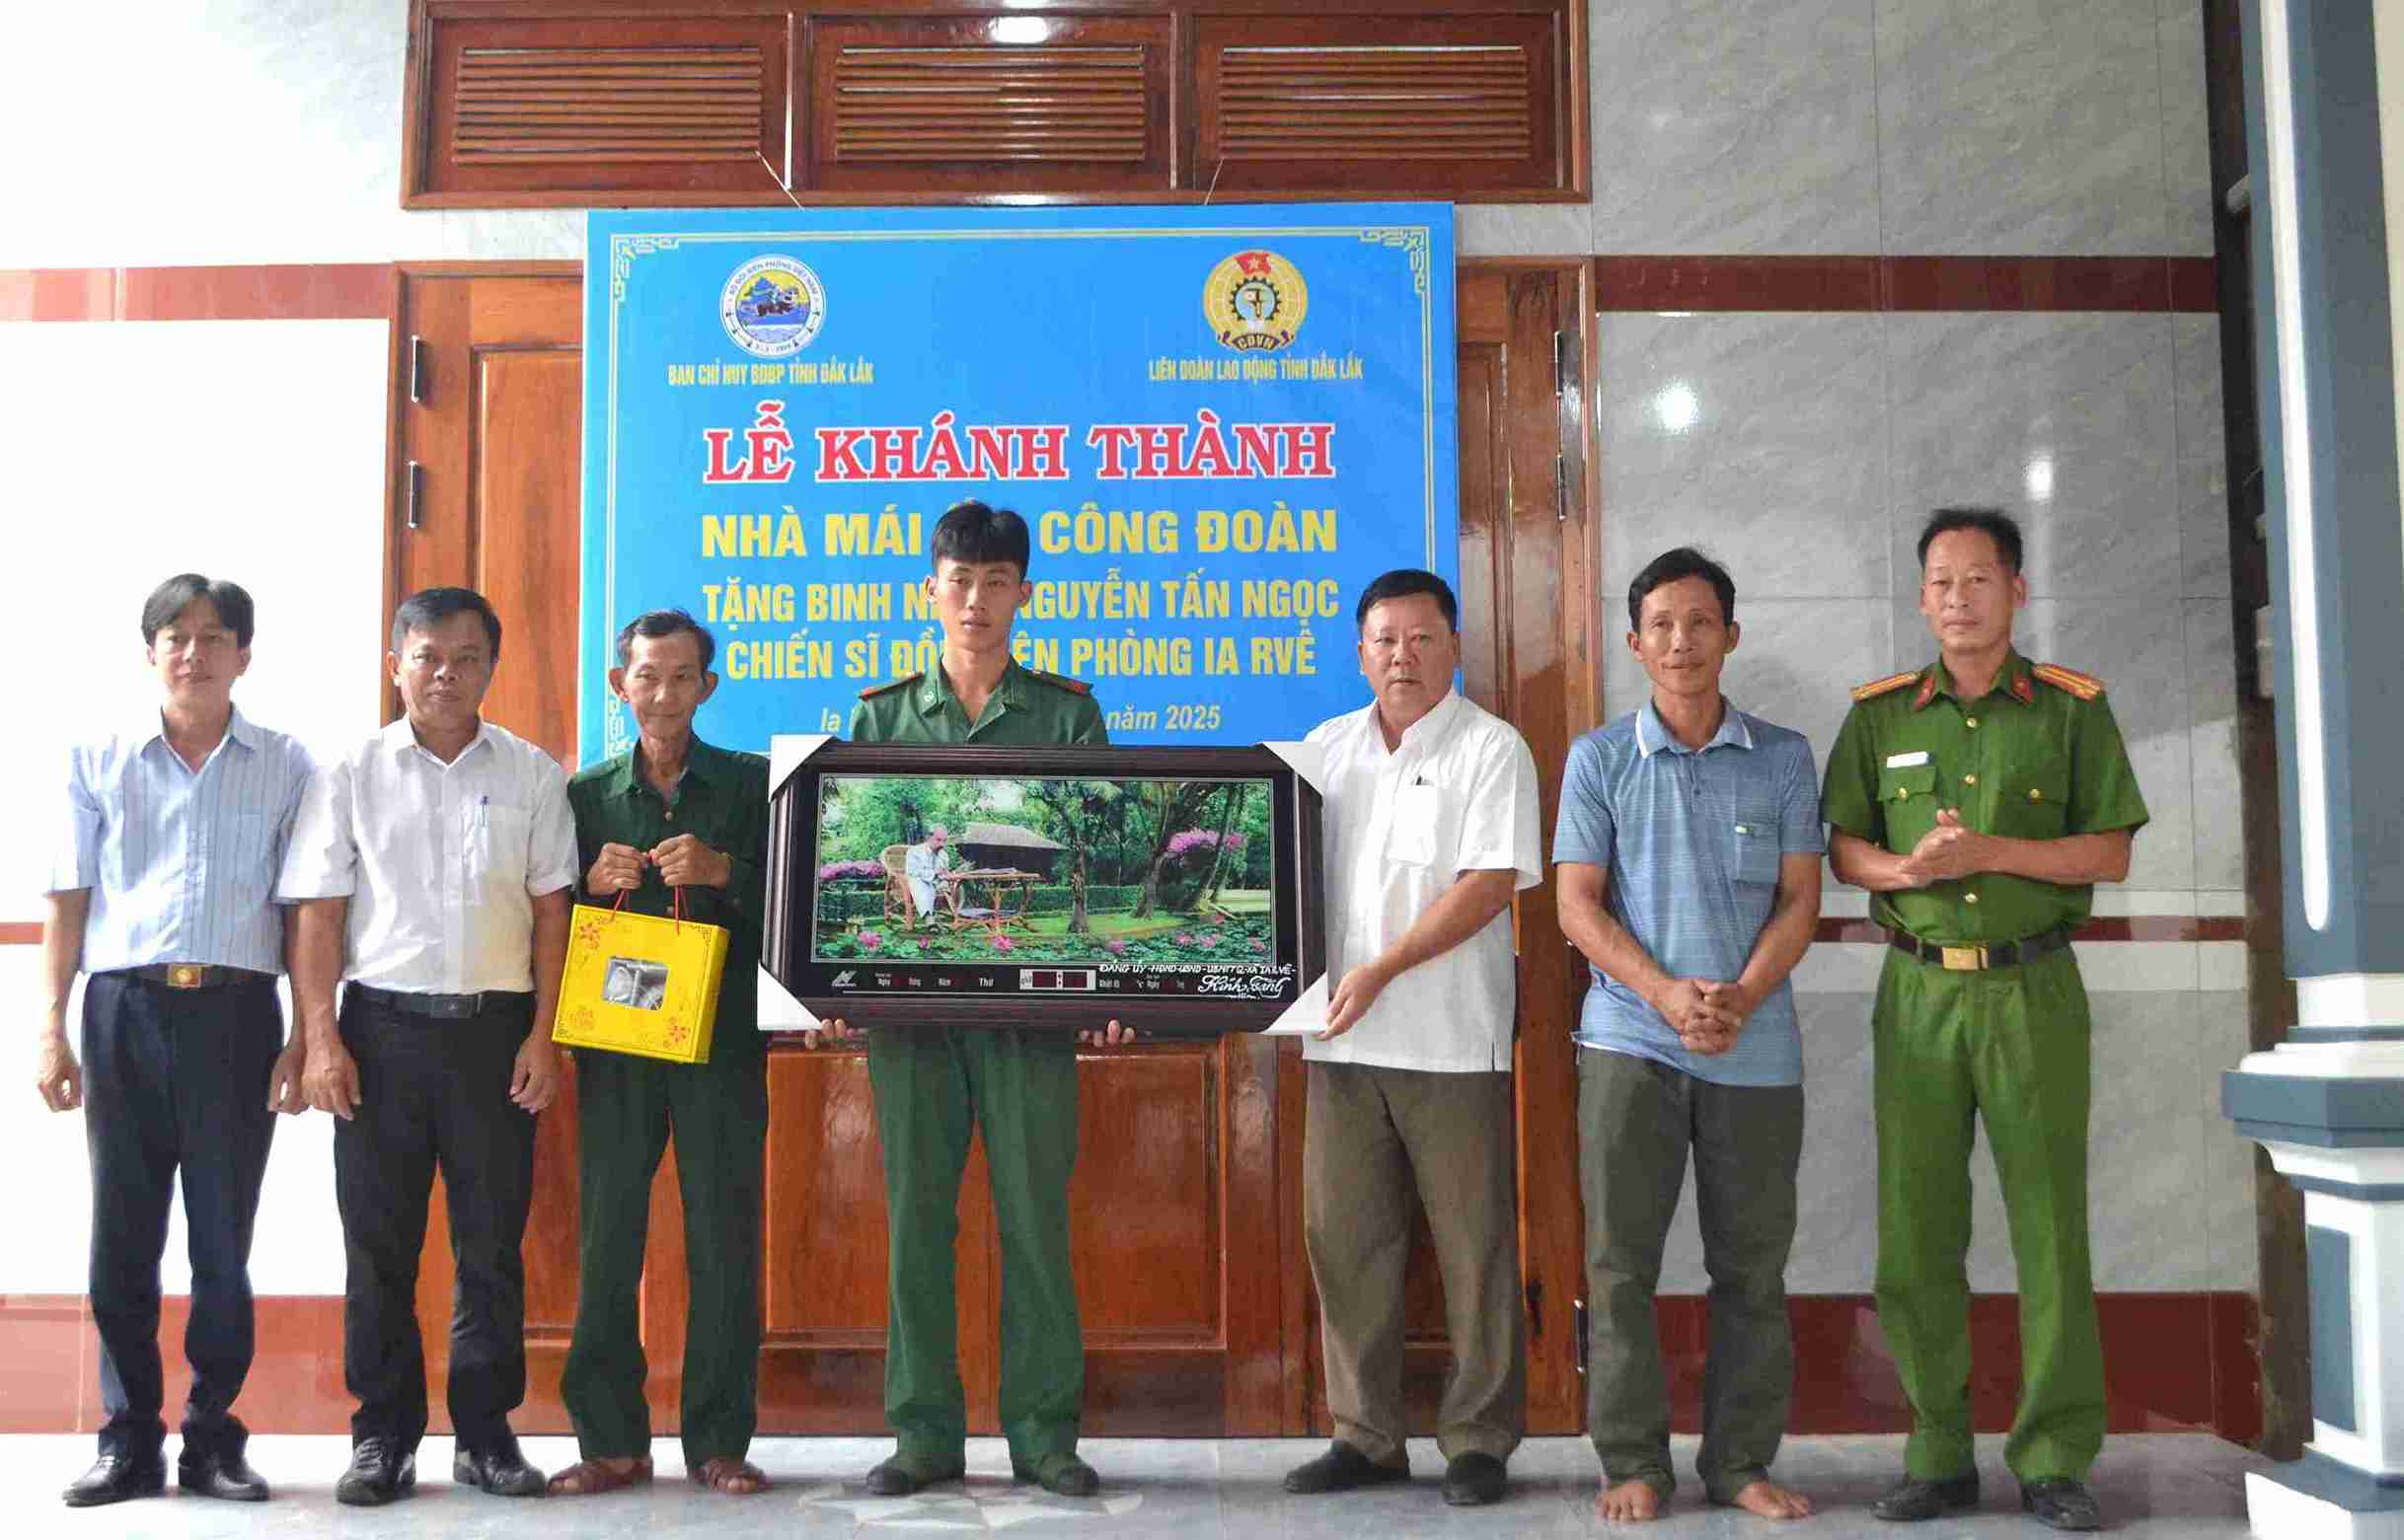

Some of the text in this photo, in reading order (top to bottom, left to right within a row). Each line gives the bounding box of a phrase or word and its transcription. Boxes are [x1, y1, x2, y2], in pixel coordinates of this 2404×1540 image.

[668, 363, 695, 386] BAN
[724, 363, 748, 385] HUY
[789, 356, 818, 385] TỈNH
[1149, 355, 1176, 380] LIÊN
[1180, 355, 1214, 380] ĐOÀN
[1217, 359, 1240, 380] LAO
[1243, 354, 1276, 386] ĐỘNG
[1281, 351, 1309, 380] TỈNH
[704, 400, 1336, 483] LỄ KHÁNH THÀNH
[702, 499, 1337, 557] NHÀ MÁI CÔNG ĐOÀN
[702, 576, 795, 630] TẶNG
[806, 583, 892, 622] BINH
[1019, 568, 1150, 620] GUYỄN
[1161, 567, 1231, 619] TẤN
[1242, 578, 1340, 626] NGỌC
[726, 627, 833, 680] CHIẾN
[844, 632, 879, 679] SĨ
[890, 626, 940, 678] ĐỒ
[1072, 627, 1192, 677] PHÒNG
[1204, 637, 1240, 676] IA
[1105, 703, 1157, 730] năm
[1166, 704, 1221, 730] 2025
